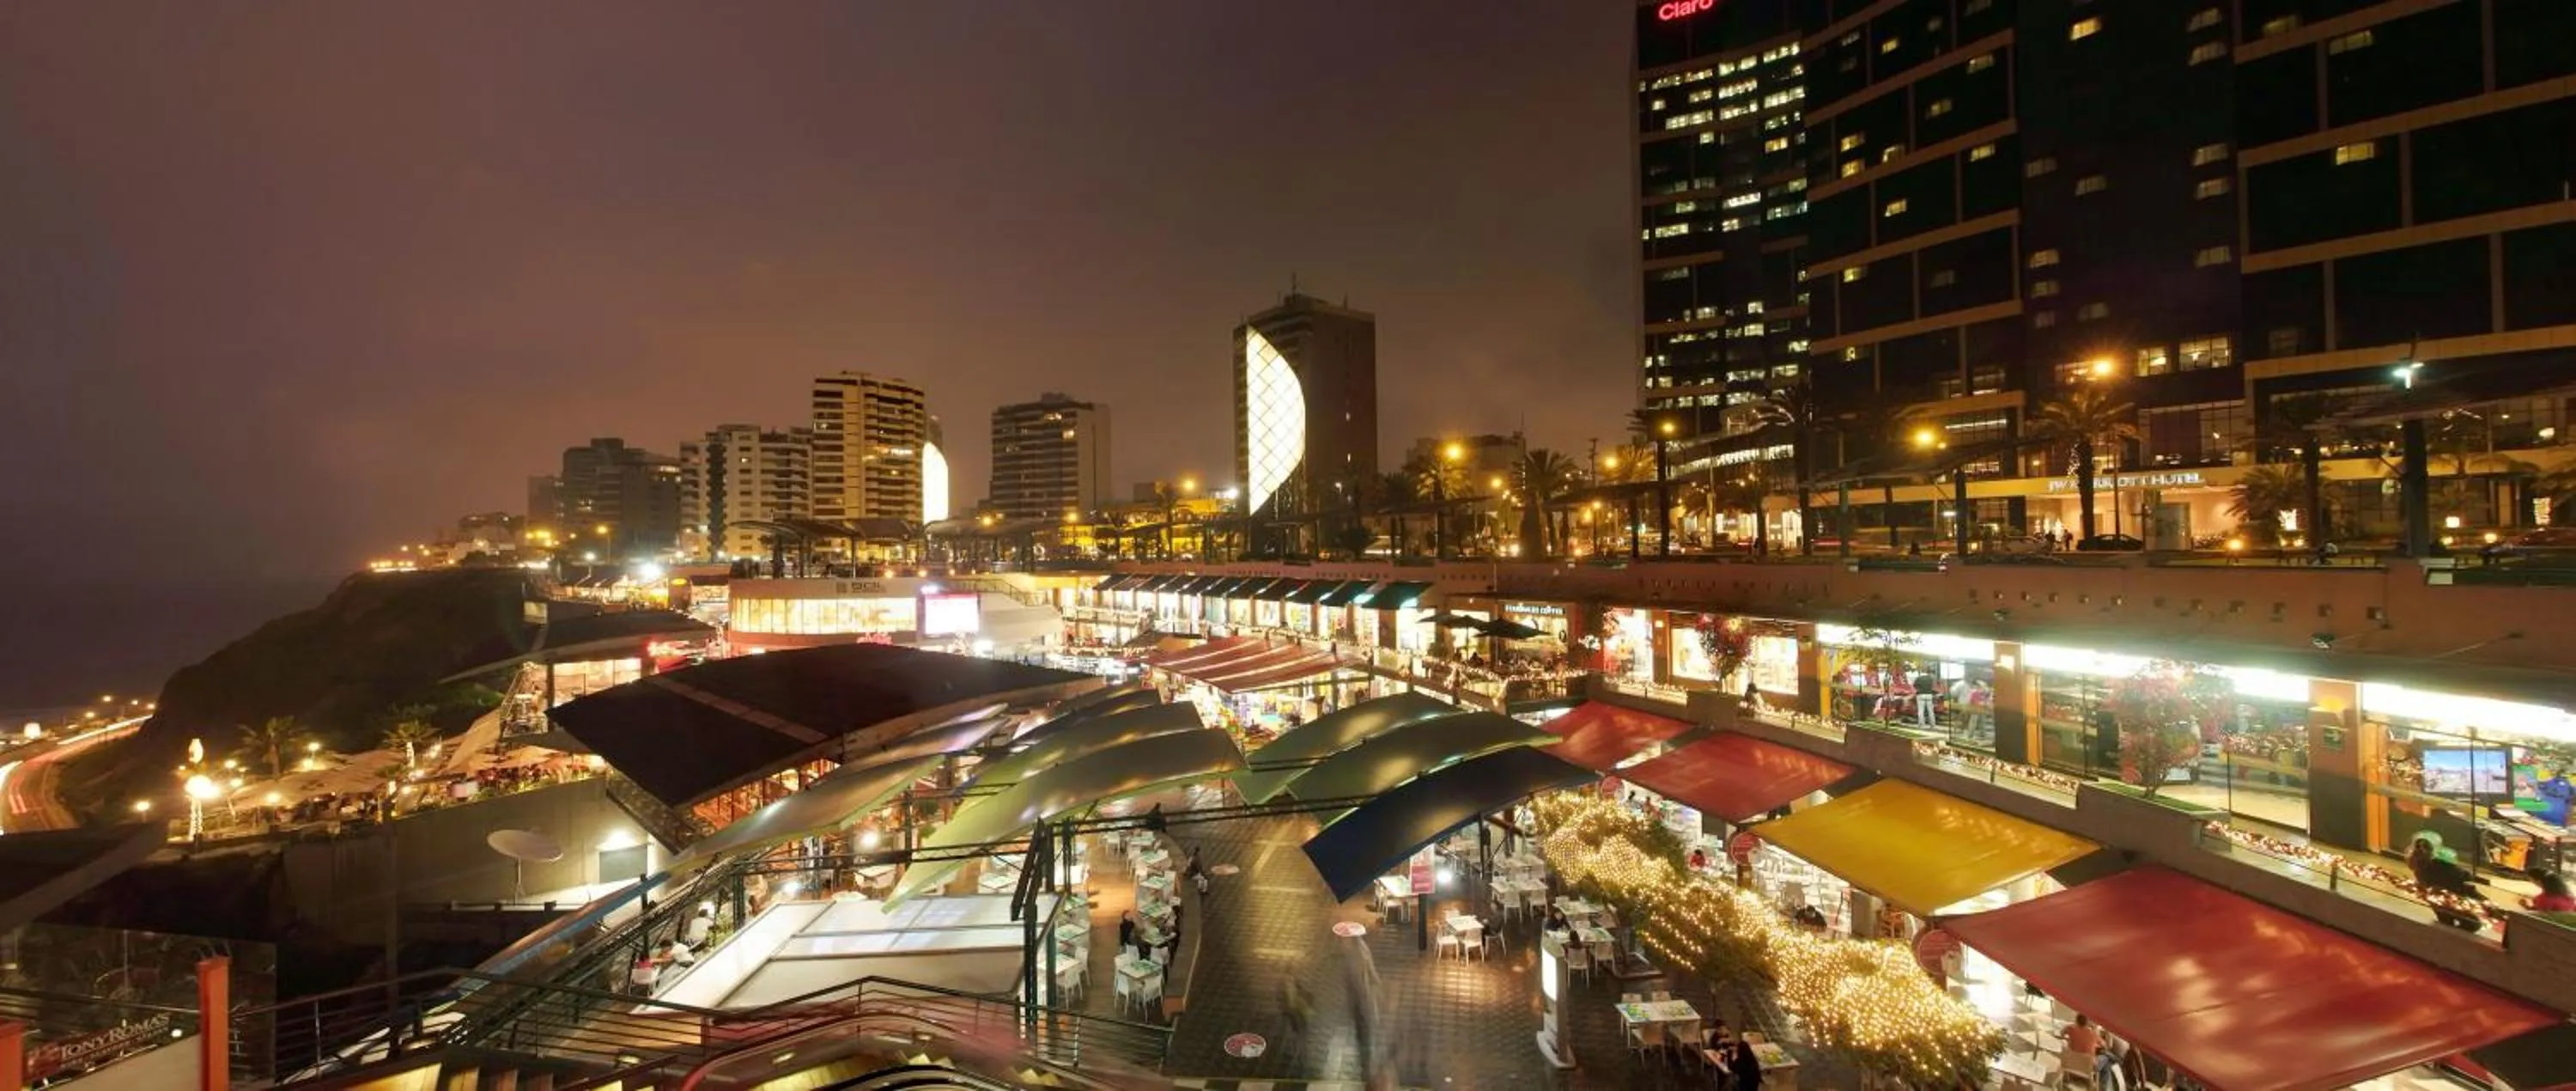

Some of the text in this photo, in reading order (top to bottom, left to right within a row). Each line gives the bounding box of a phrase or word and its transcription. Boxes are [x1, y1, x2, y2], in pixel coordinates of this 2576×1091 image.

[1658, 0, 1713, 21] Claro
[2150, 472, 2202, 485] HOTEL
[61, 1032, 109, 1060] TONY
